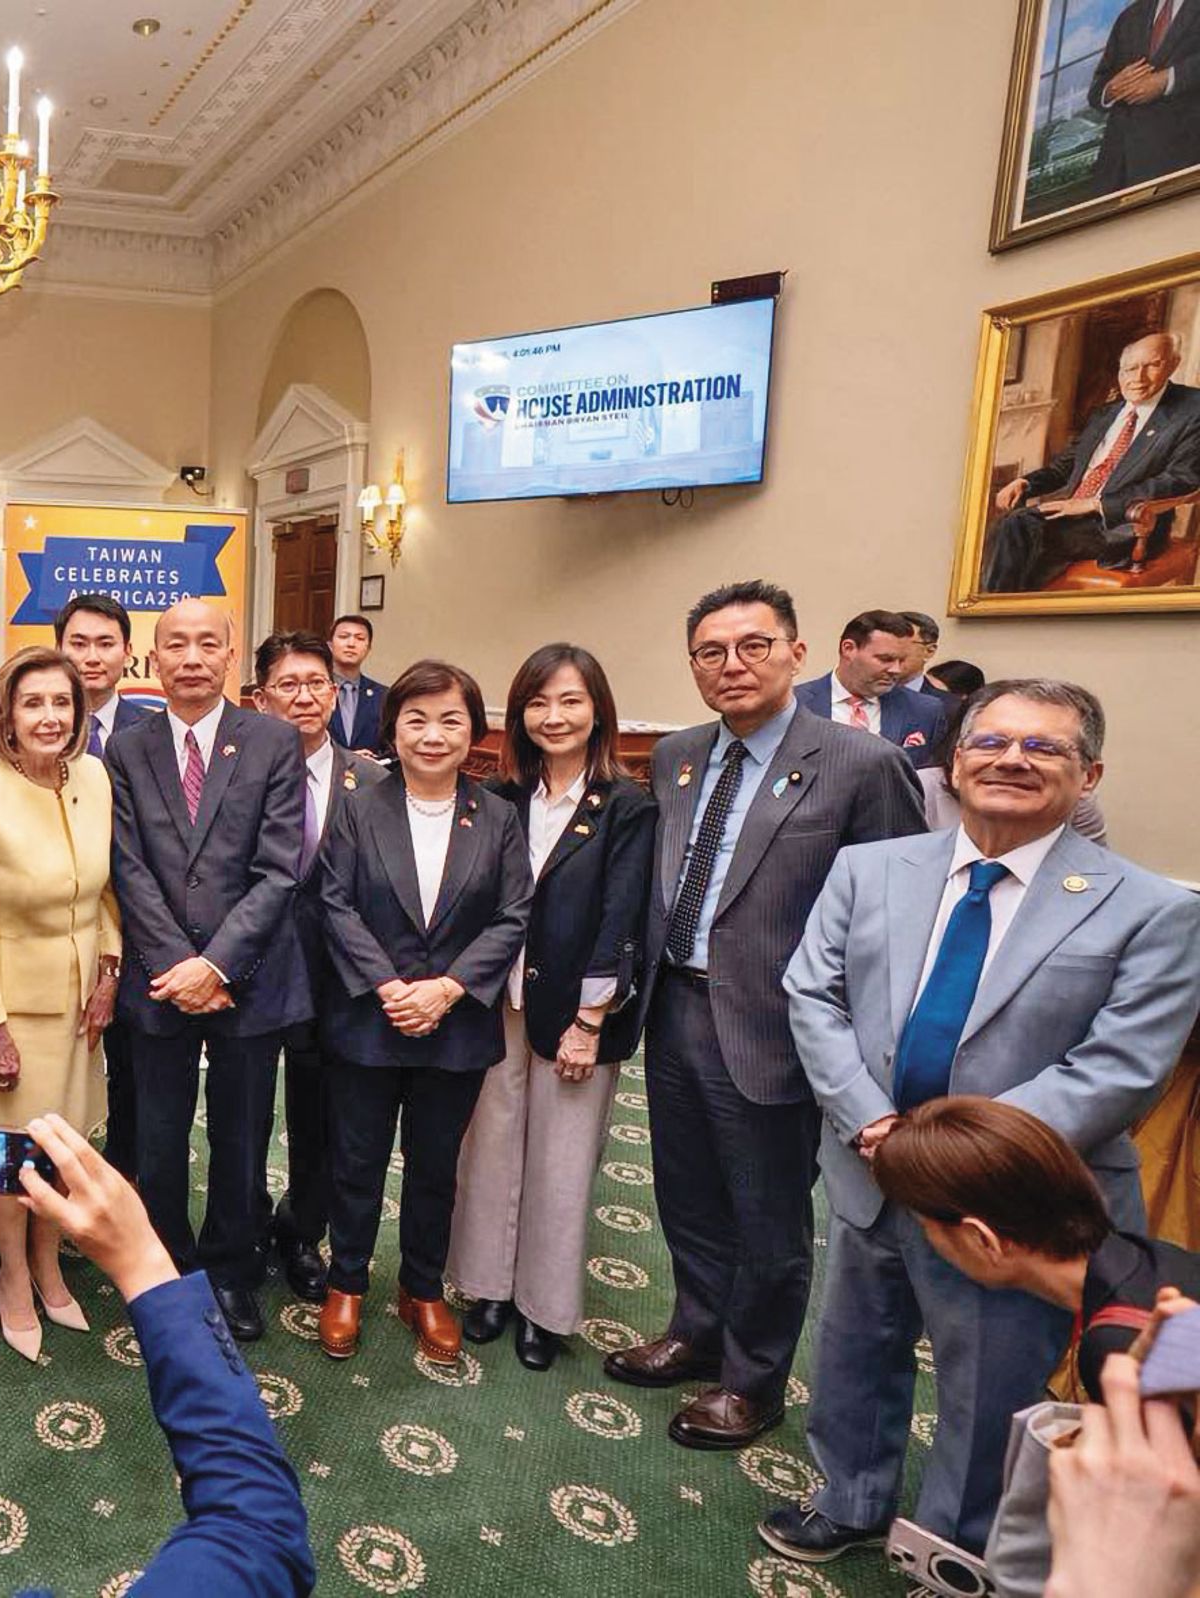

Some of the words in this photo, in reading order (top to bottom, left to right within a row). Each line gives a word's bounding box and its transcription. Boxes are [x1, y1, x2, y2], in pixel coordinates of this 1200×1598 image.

[545, 343, 561, 354] PM
[516, 377, 604, 398] COMMITTEE
[606, 373, 630, 387] ON
[516, 393, 573, 420] HOUSE
[576, 373, 742, 414] ADMINISTRATION
[601, 412, 630, 421] STEIL
[87, 546, 162, 564] TAIWAN
[54, 566, 180, 585] CELEBRATES
